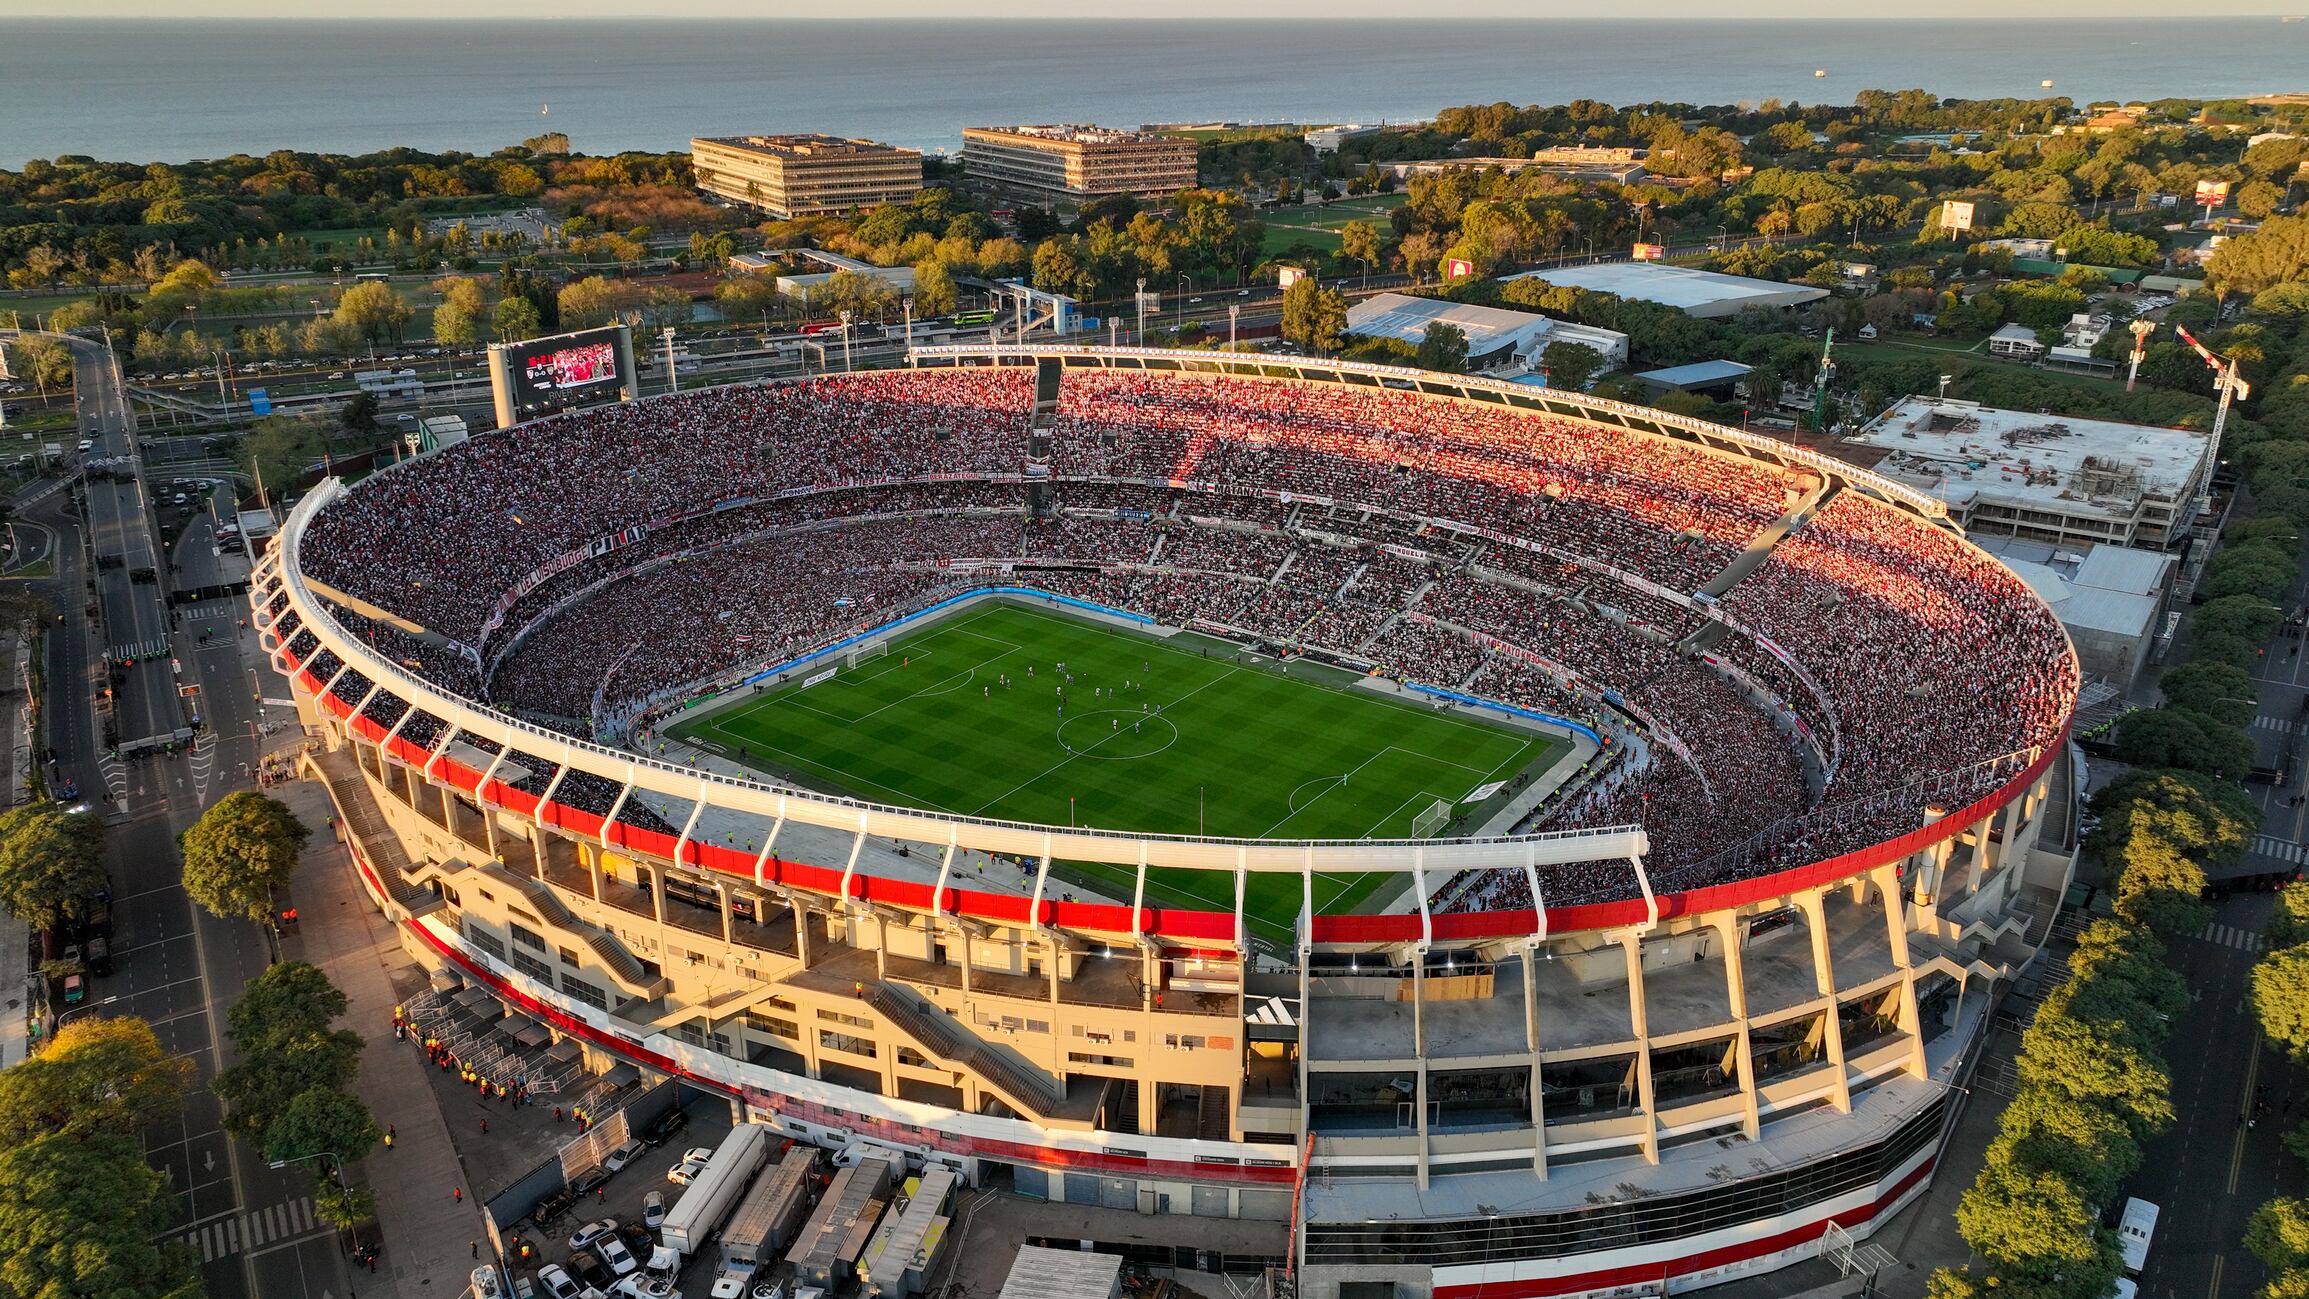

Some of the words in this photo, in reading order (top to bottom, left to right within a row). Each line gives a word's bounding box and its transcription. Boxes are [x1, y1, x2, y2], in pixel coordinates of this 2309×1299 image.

[548, 389, 573, 400] RIVER
[815, 479, 849, 490] SOMOS
[853, 477, 888, 487] FIESTA
[1215, 484, 1262, 497] MATANZA
[1334, 500, 1357, 510] LINIERS
[589, 524, 648, 557] PILAR
[1480, 529, 1518, 544] ADICTO
[1385, 545, 1425, 558] QUINQUELA
[520, 573, 537, 594] DEL
[537, 559, 554, 582] VISO
[555, 545, 588, 571] BUDGE
[975, 566, 1014, 577] HUDSON
[1410, 612, 1435, 625] BUDGE
[1502, 643, 1520, 657] MAYO
